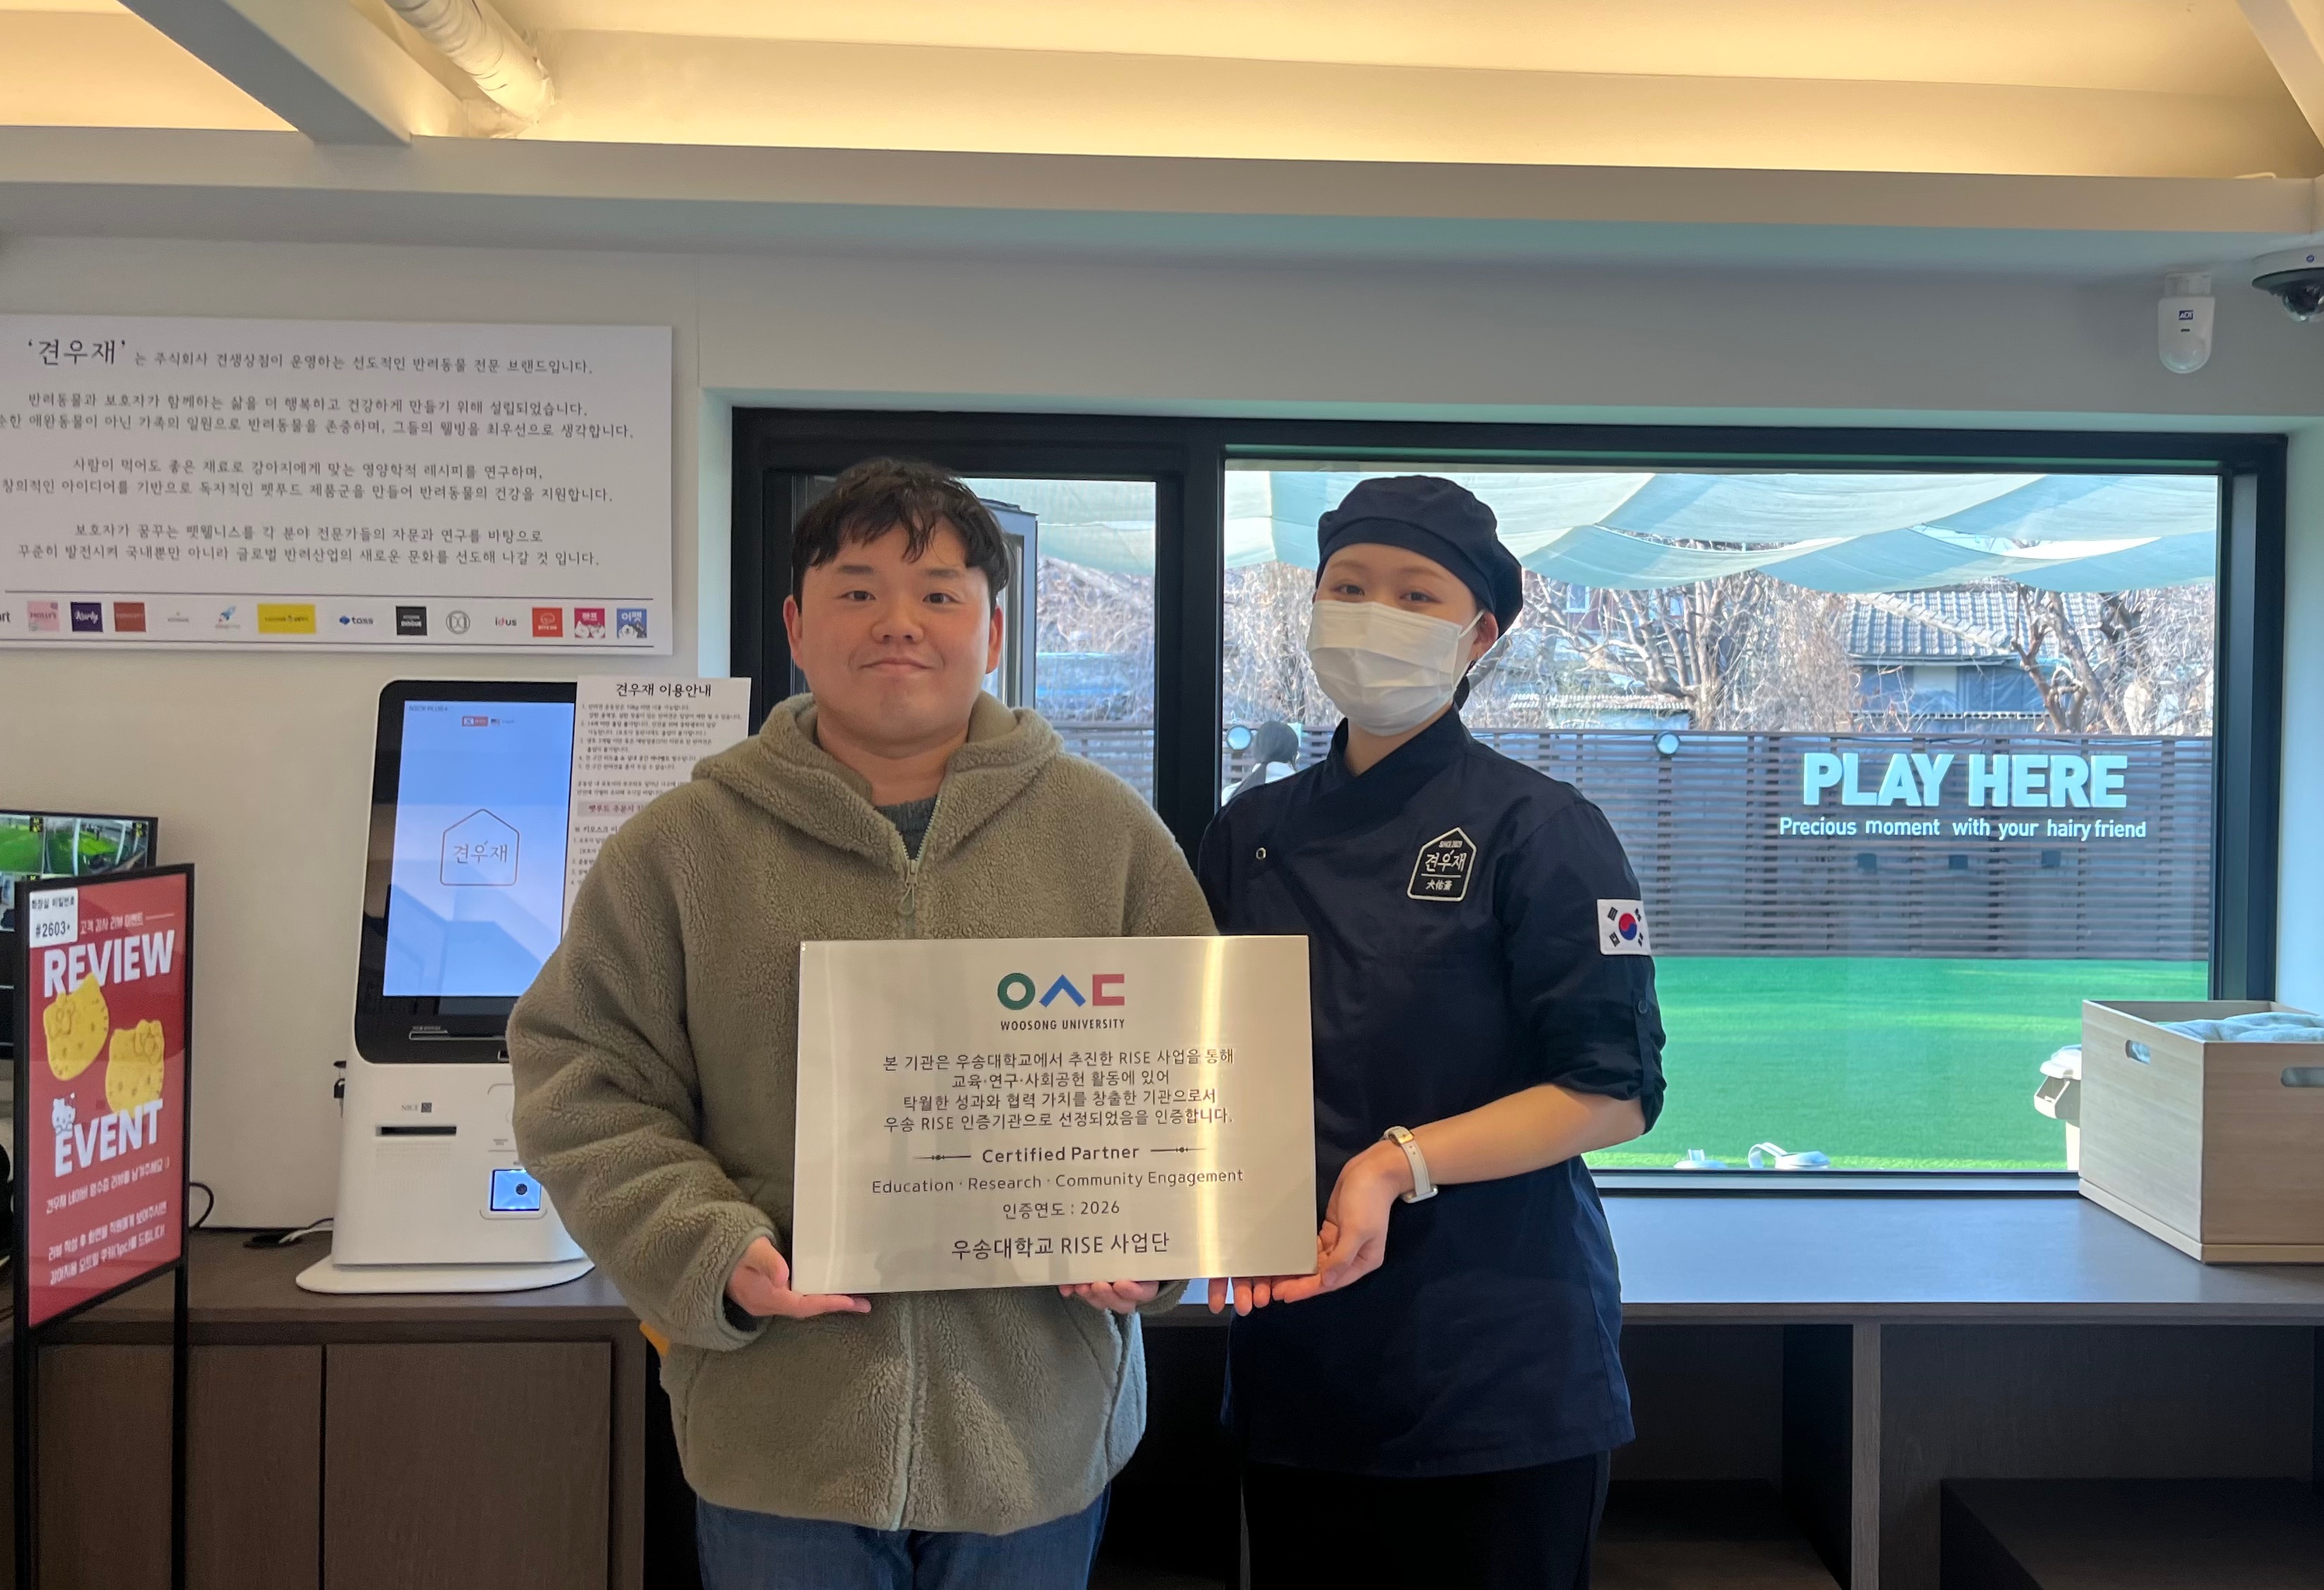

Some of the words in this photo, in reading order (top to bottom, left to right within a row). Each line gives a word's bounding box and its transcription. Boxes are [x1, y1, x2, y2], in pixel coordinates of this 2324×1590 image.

[135, 351, 147, 367] 는
[154, 351, 208, 367] 주식회사
[290, 354, 345, 371] 운영하는
[353, 355, 405, 372] 선도적인
[412, 357, 467, 374] 반려동물
[474, 358, 500, 374] 전문
[507, 358, 592, 375] 브랜드입니다.
[28, 392, 97, 408] 반려동물과
[104, 393, 161, 409] 보호자가
[168, 393, 224, 411] 함께하는
[231, 395, 256, 412] 삶을
[285, 396, 340, 412] 행복하고
[348, 398, 402, 414] 건강하게
[409, 398, 449, 415] 만들기
[456, 400, 483, 415] 위해
[490, 400, 587, 417] 설립되었습니다.
[29, 414, 97, 430] 애완동물이
[104, 414, 131, 430] 아닌
[139, 414, 179, 432] 가족의
[186, 416, 241, 432] 일원으로
[247, 416, 318, 434] 반려동물을
[325, 419, 385, 435] 존중하며,
[392, 420, 433, 436] 그들의
[440, 421, 480, 437] 웰빙을
[487, 421, 554, 438] 최우선으로
[560, 423, 634, 440] 생각합니다.
[73, 456, 114, 473] 사람이
[121, 458, 162, 474] 먹어도
[168, 458, 196, 475] 좋은
[203, 459, 244, 475] 재료로
[252, 460, 320, 476] 강아지에게
[327, 461, 355, 477] 맞는
[362, 462, 416, 479] 영양학적
[423, 463, 477, 480] 레시피를
[484, 464, 543, 480] 연구하며,
[2, 478, 55, 495] 창의적인
[61, 479, 128, 496] 아이디어를
[137, 480, 193, 496] 기반으로
[199, 481, 253, 498] 독자적인
[260, 482, 303, 498] 펫푸드
[309, 482, 365, 500] 제품군을
[372, 484, 412, 500] 만들어
[419, 484, 487, 501] 반려동물의
[495, 486, 535, 502] 건강을
[541, 487, 613, 503] 지원합니다.
[74, 523, 130, 538] 보호자가
[137, 523, 179, 540] 꿈꾸는
[262, 525, 276, 541] 각
[283, 525, 311, 541] 분야
[318, 526, 385, 543] 전문가들의
[392, 526, 434, 543] 자문과
[441, 528, 482, 544] 연구를
[487, 529, 543, 545] 바탕으로
[18, 543, 57, 559] 꾸준히
[64, 544, 118, 560] 발전시켜
[125, 545, 180, 562] 국내뿐만
[188, 545, 229, 561] 아니라
[236, 546, 277, 563] 글로벌
[284, 547, 352, 564] 반려산업의
[359, 548, 401, 564] 새로운
[407, 549, 449, 565] 문화를
[456, 549, 496, 565] 선도해
[502, 550, 530, 566] 나갈
[536, 550, 548, 566] 것
[555, 550, 599, 567] 입니다.
[351, 616, 374, 625] toss
[495, 617, 517, 627] idus
[616, 683, 655, 697] 견우재
[659, 683, 712, 698] 이용안내
[1803, 752, 1955, 806] PLAY
[1969, 754, 2128, 808] HERE
[1779, 816, 1858, 836] Precious
[1865, 818, 1941, 836] moment
[1952, 817, 1990, 836] with
[1999, 822, 2040, 841] your
[2046, 818, 2092, 842] hairy
[2094, 819, 2147, 838] friend
[453, 841, 508, 864] 견우재
[1425, 850, 1467, 872] 견우재
[44, 929, 175, 998] REVIEW
[1000, 1019, 1057, 1031] WOOSONG
[1061, 1018, 1125, 1030] UNIVERSITY
[883, 1055, 898, 1072] 본
[904, 1054, 950, 1071] 기관은
[956, 1052, 1062, 1071] 우송대학교에서
[1068, 1050, 1114, 1068] 추진한
[1119, 1051, 1150, 1065] RISE
[1157, 1049, 1201, 1066] 사업을
[1207, 1047, 1233, 1064] 통해
[1091, 1069, 1135, 1087] 활동에
[1141, 1069, 1169, 1085] 있어
[904, 1094, 949, 1112] 탁월한
[955, 1093, 1001, 1110] 성과와
[1006, 1092, 1035, 1109] 협력
[1041, 1091, 1087, 1108] 가치를
[1092, 1089, 1137, 1107] 창출한
[1143, 1089, 1216, 1106] 기관으로서
[883, 1116, 915, 1133] 우송
[921, 1116, 954, 1131] RISE
[960, 1113, 1053, 1131] 인증기관으로
[1059, 1109, 1149, 1128] 선정되었음을
[1155, 1107, 1232, 1125] 인증합니다.
[55, 1099, 163, 1178] EVENT
[982, 1146, 1066, 1164] Certified
[1071, 1146, 1140, 1161] Partner
[872, 1178, 953, 1194] Education
[968, 1174, 1042, 1191] Research
[1055, 1171, 1143, 1188] Community
[1148, 1169, 1244, 1188] Engagement
[1003, 1202, 1066, 1221] 인증연도
[1080, 1200, 1120, 1215] 2026
[951, 1236, 1054, 1261] 우송대학교
[1061, 1235, 1103, 1255] RISE
[1110, 1231, 1170, 1255] 사업단
